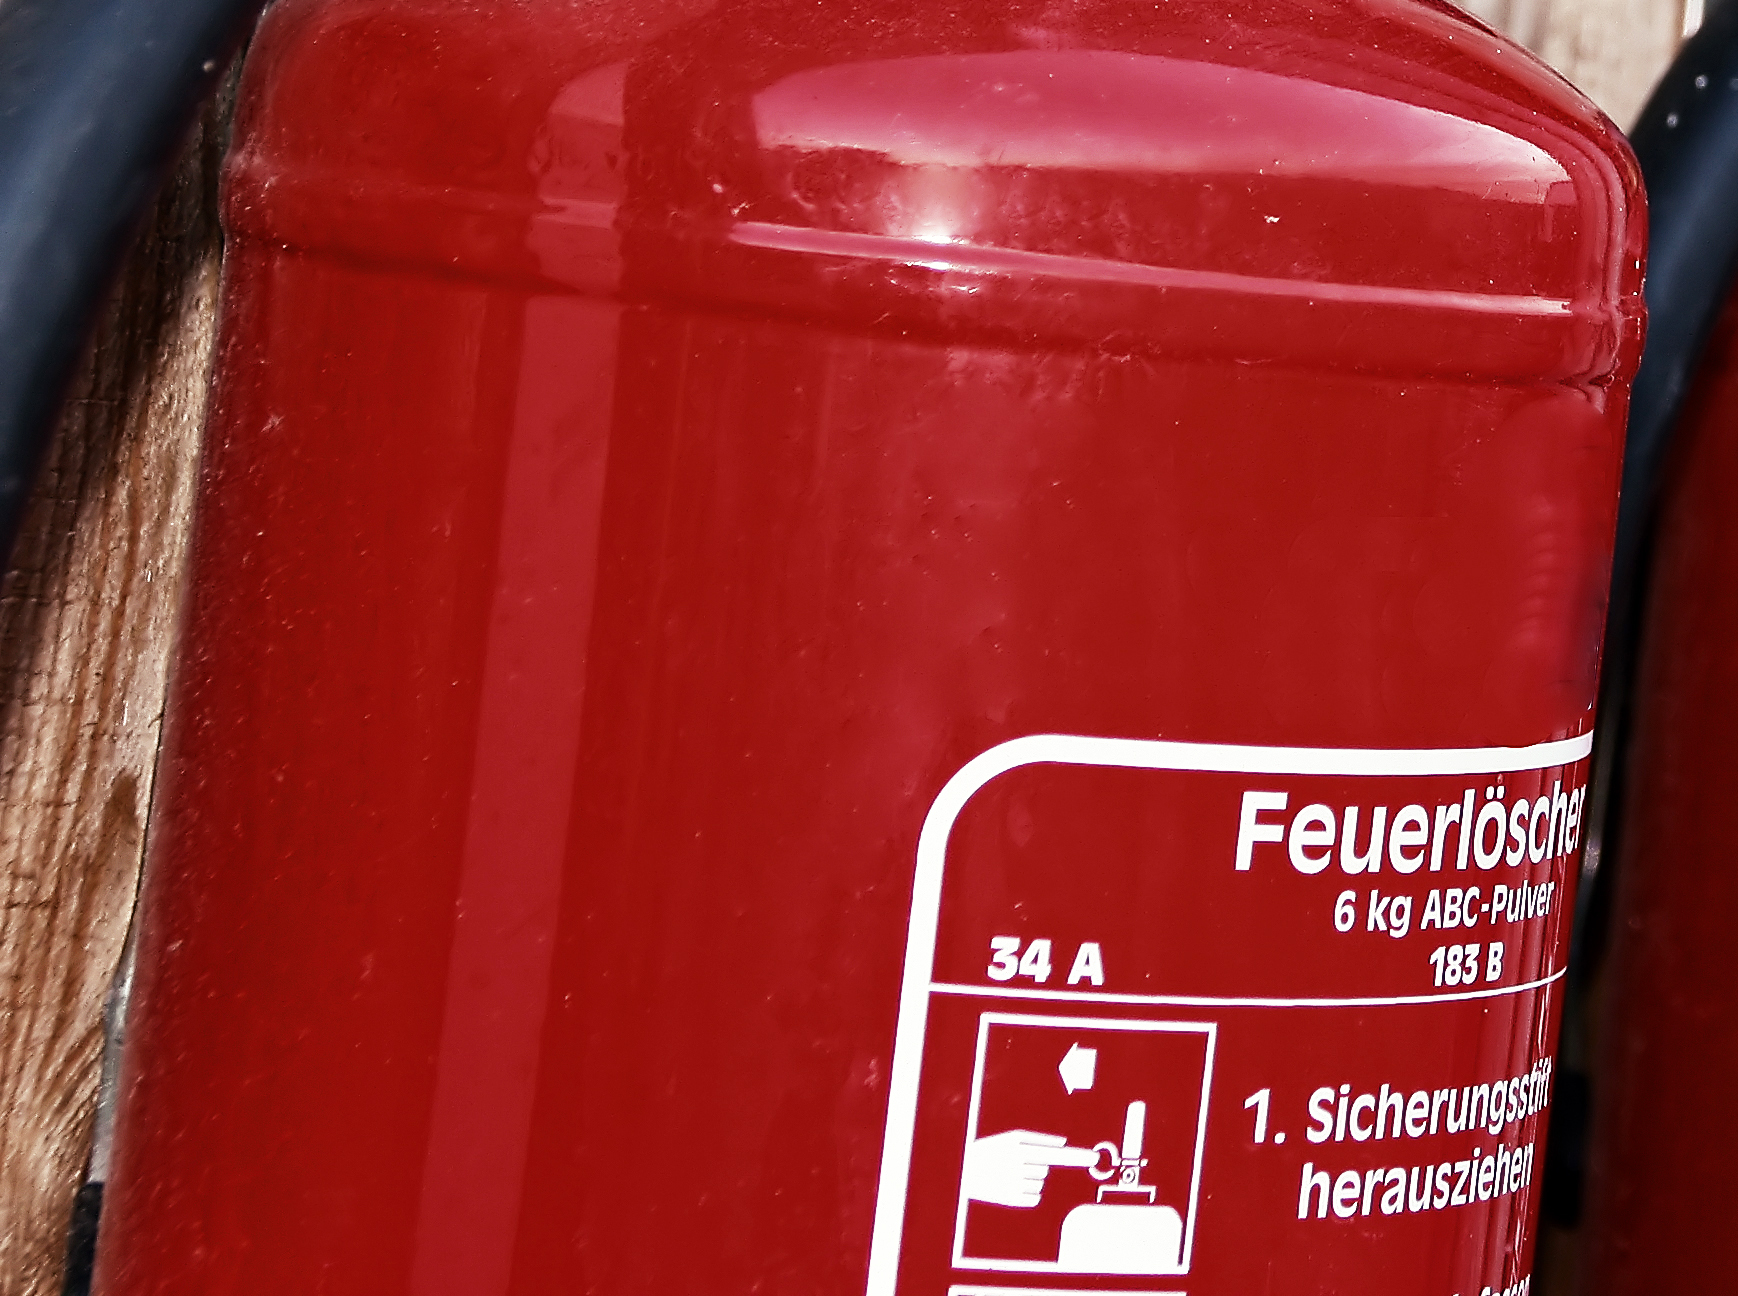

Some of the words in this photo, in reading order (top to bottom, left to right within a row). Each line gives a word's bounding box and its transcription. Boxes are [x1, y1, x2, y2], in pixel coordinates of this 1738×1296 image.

[1235, 780, 1586, 875] Feuerlöscher
[1334, 890, 1357, 933] 6
[1367, 889, 1412, 938] kg
[1420, 879, 1555, 930] ABC-Pulver
[987, 935, 1051, 983] 34
[1066, 942, 1105, 986] A
[1429, 943, 1480, 987] 183
[1485, 941, 1504, 982] B
[1243, 1088, 1286, 1144] 1.
[1305, 1056, 1552, 1144] Sicherungsstift
[1297, 1142, 1534, 1219] herausziehen
